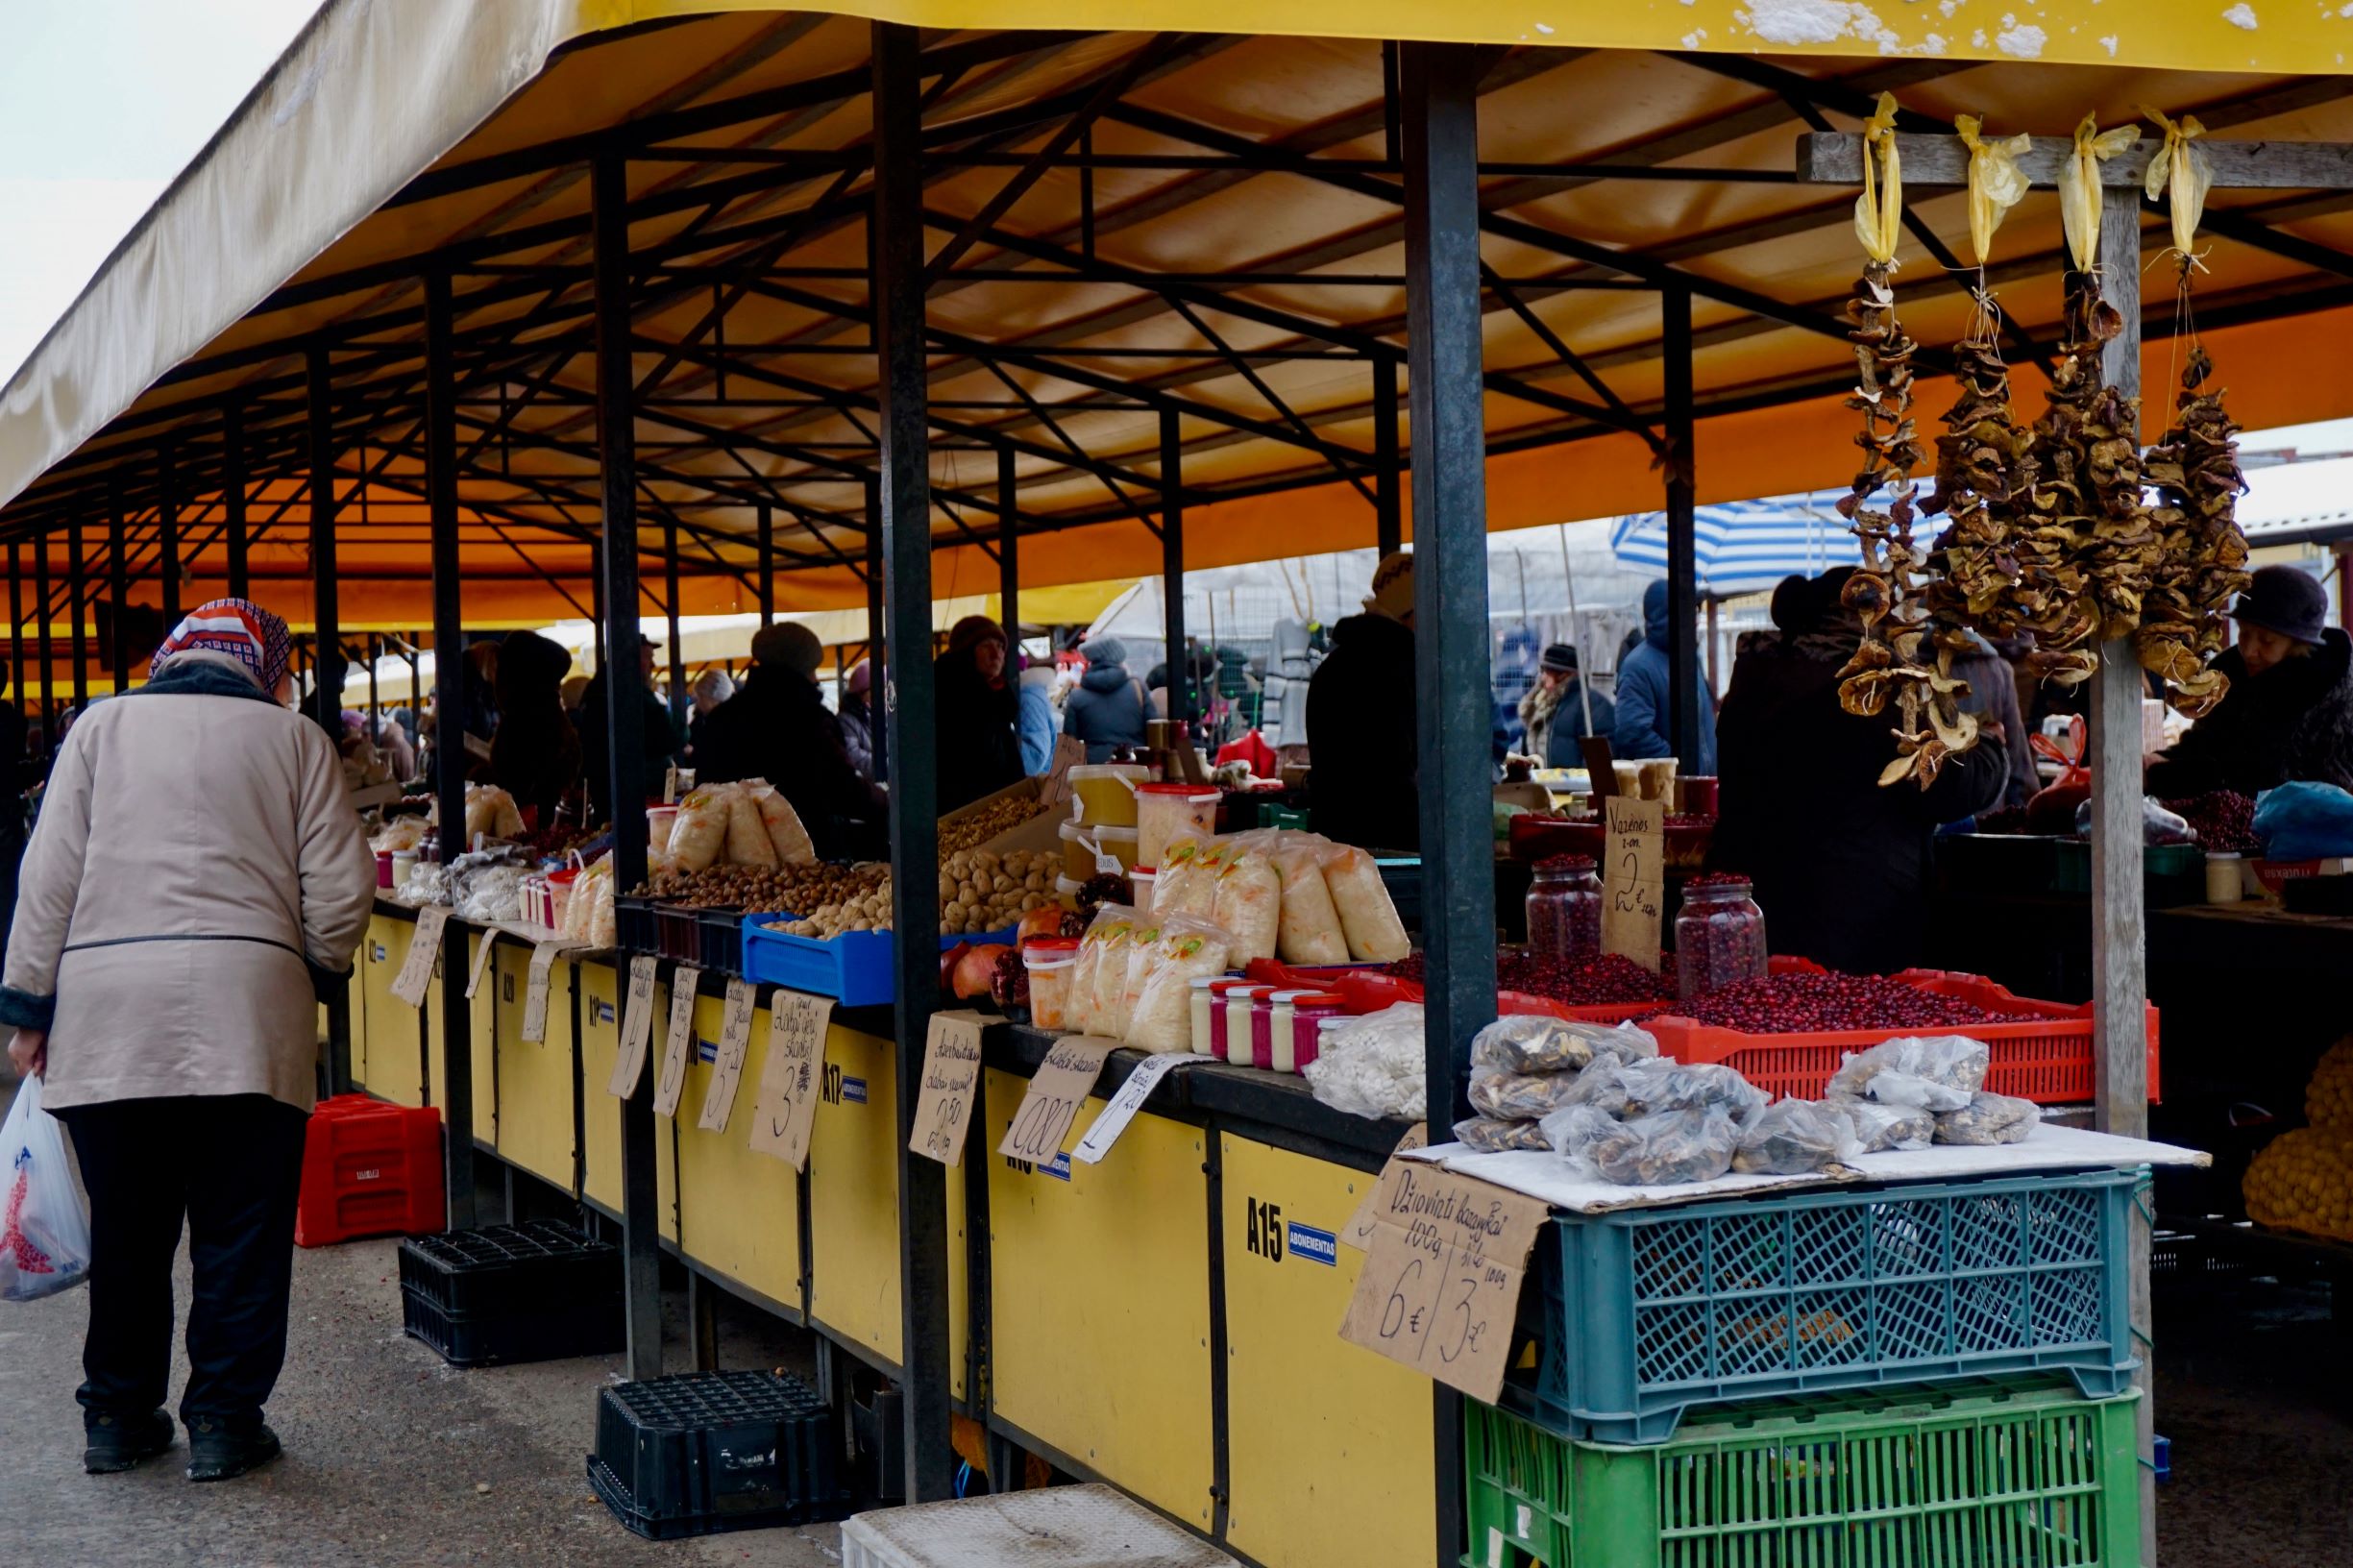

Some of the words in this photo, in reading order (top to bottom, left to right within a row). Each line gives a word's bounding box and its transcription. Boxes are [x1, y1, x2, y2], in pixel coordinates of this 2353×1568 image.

[1097, 857, 1114, 869] EDUS
[772, 1066, 795, 1138] 3
[822, 1062, 841, 1105] A17
[1247, 1196, 1283, 1262] A15
[1289, 1231, 1335, 1256] ABONEMENTAS
